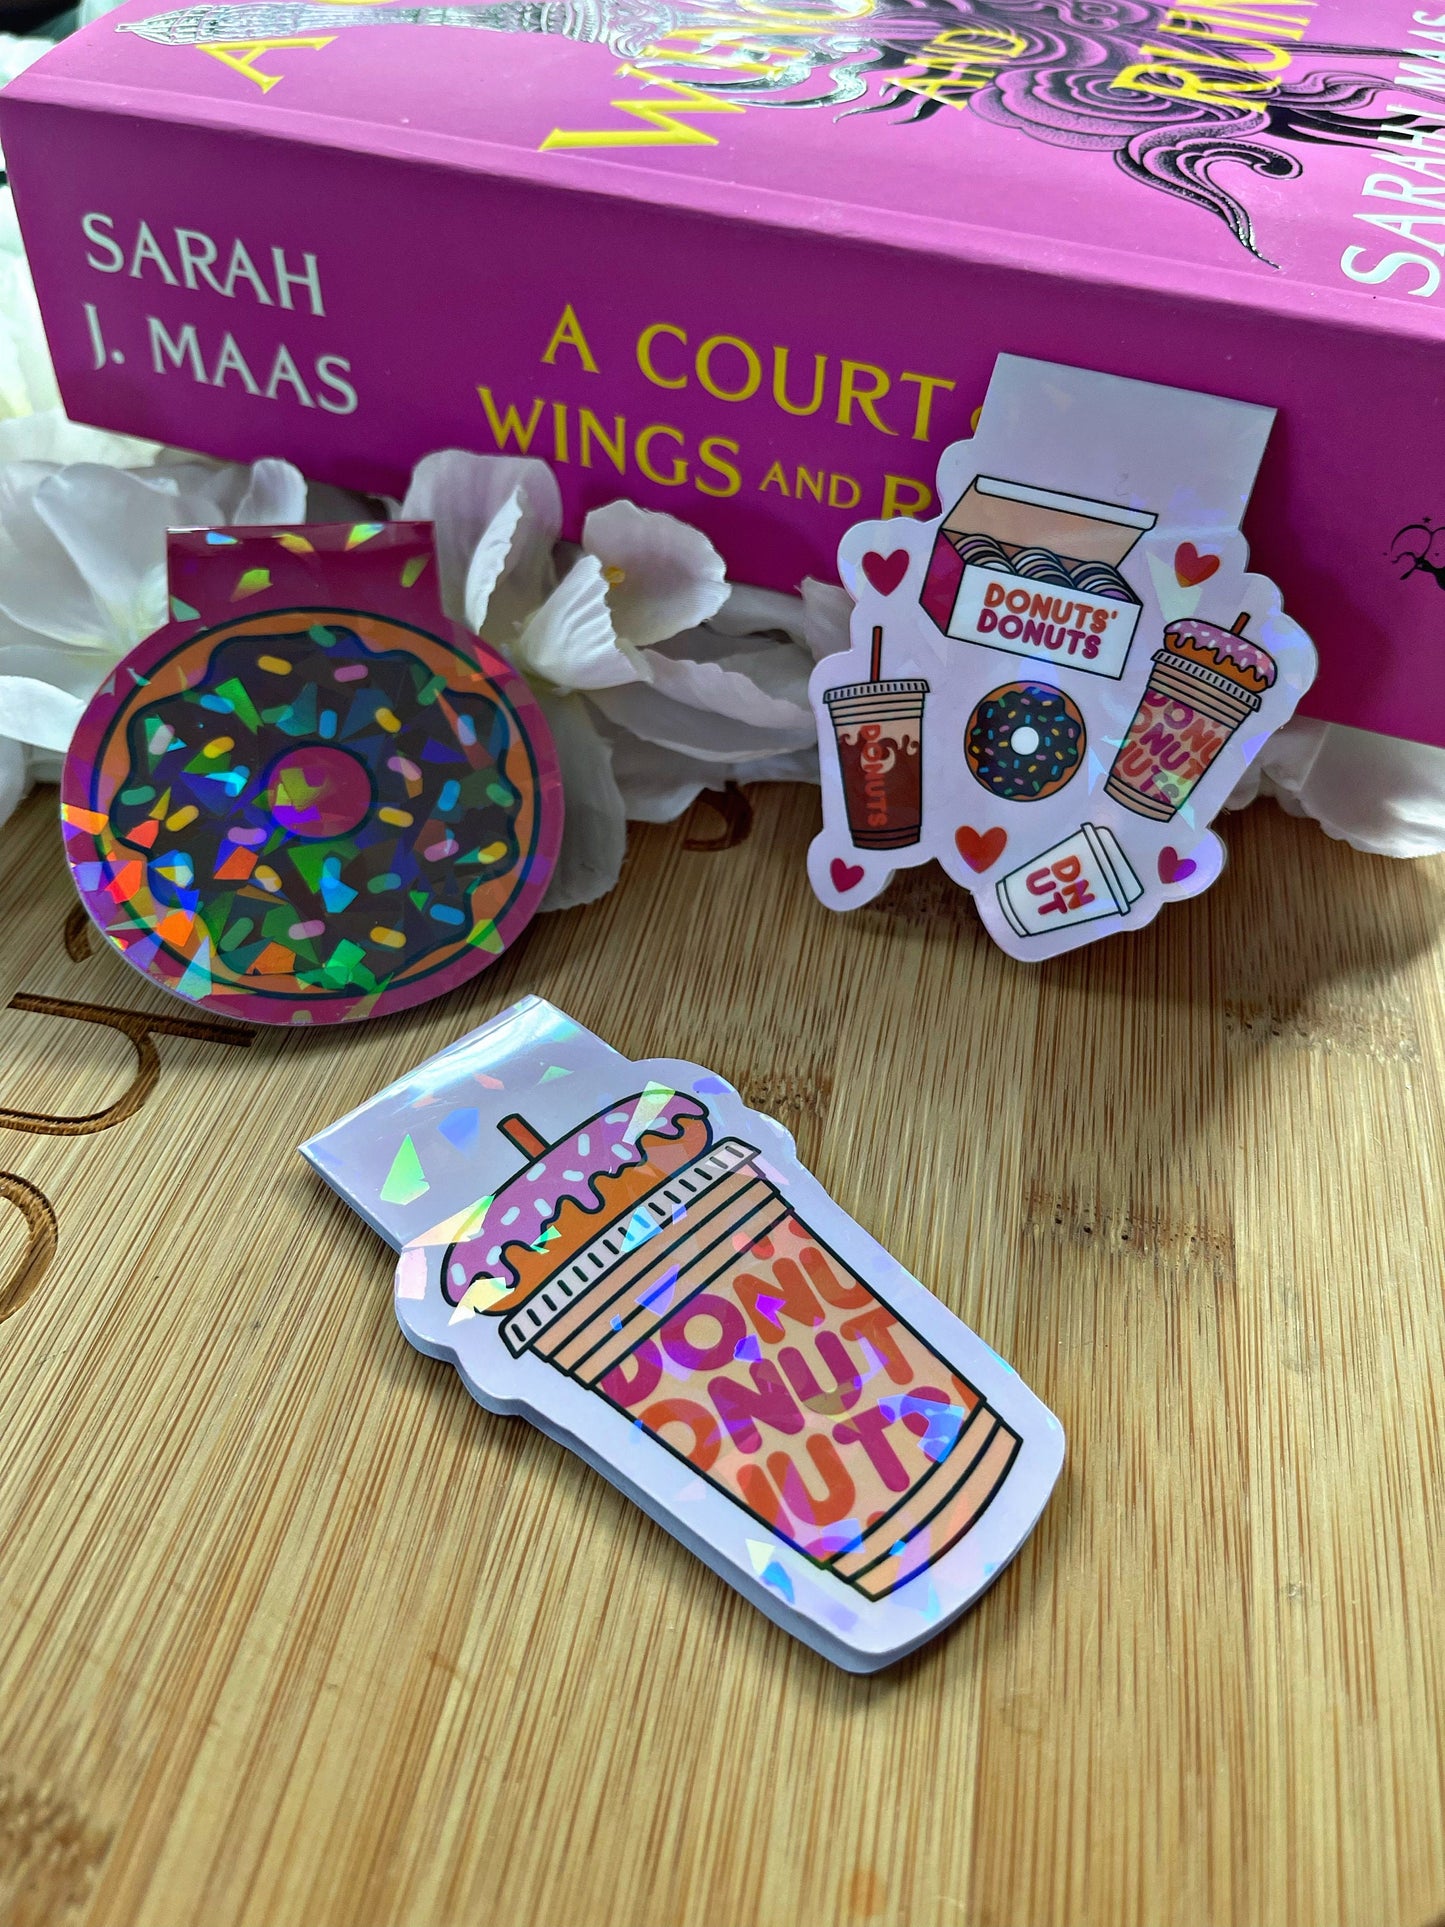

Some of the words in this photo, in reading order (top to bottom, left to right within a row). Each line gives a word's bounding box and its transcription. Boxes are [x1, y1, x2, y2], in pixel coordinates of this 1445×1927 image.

[196, 36, 338, 94] A
[881, 28, 1028, 111] AND
[1340, 124, 1445, 297] SARAH
[81, 212, 327, 317] SARAH
[82, 303, 127, 371] J.
[146, 316, 359, 415] MAAS
[540, 303, 601, 375] A
[635, 322, 957, 443] COURT
[475, 384, 744, 499] WINGS
[758, 460, 862, 511] AND
[976, 608, 1102, 660] DONUTS
[983, 581, 1118, 634] DONUTS'
[860, 724, 888, 827] DONUTS
